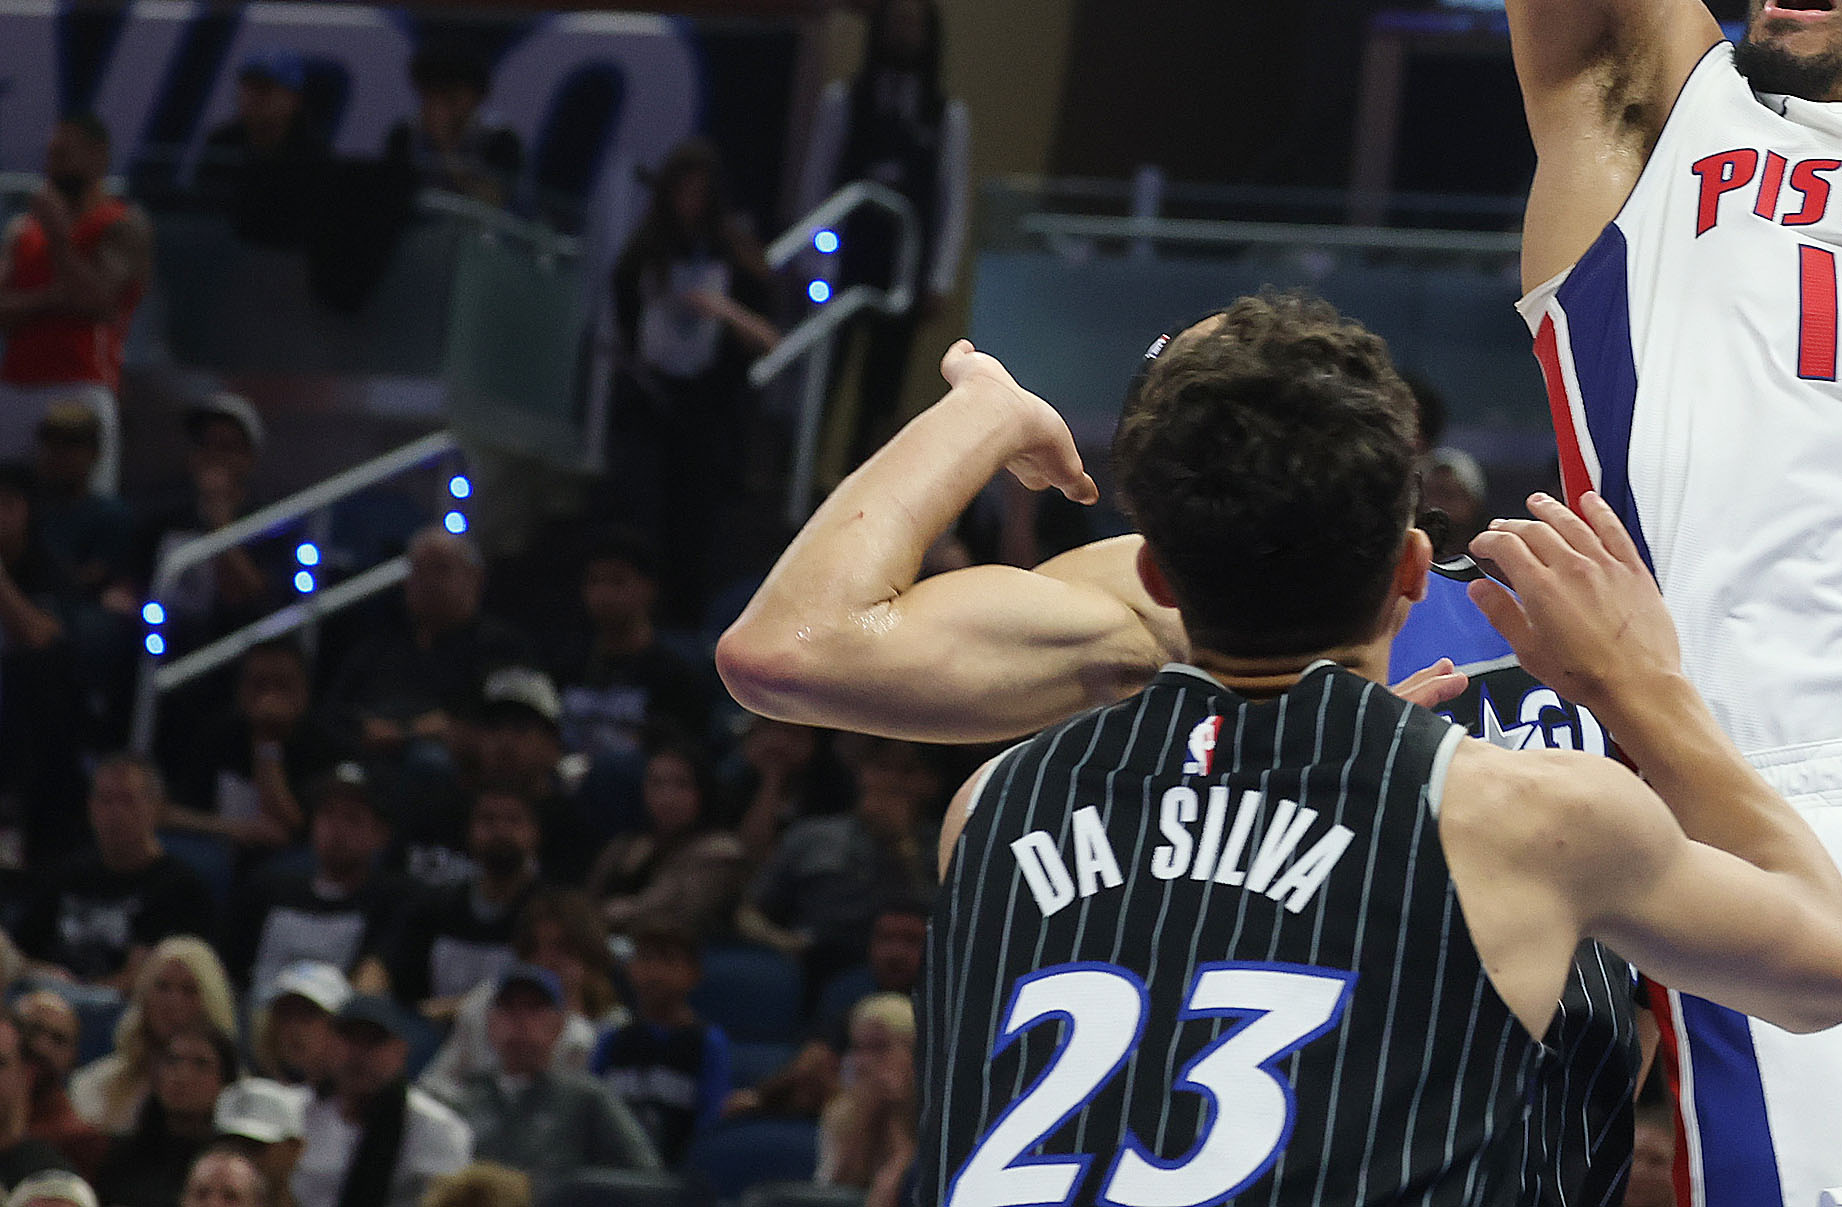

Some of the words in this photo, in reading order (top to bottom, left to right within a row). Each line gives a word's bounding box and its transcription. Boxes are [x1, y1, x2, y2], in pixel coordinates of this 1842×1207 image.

[1008, 804, 1126, 918] DA
[1149, 784, 1357, 915] SILVA
[943, 959, 1360, 1207] 23
